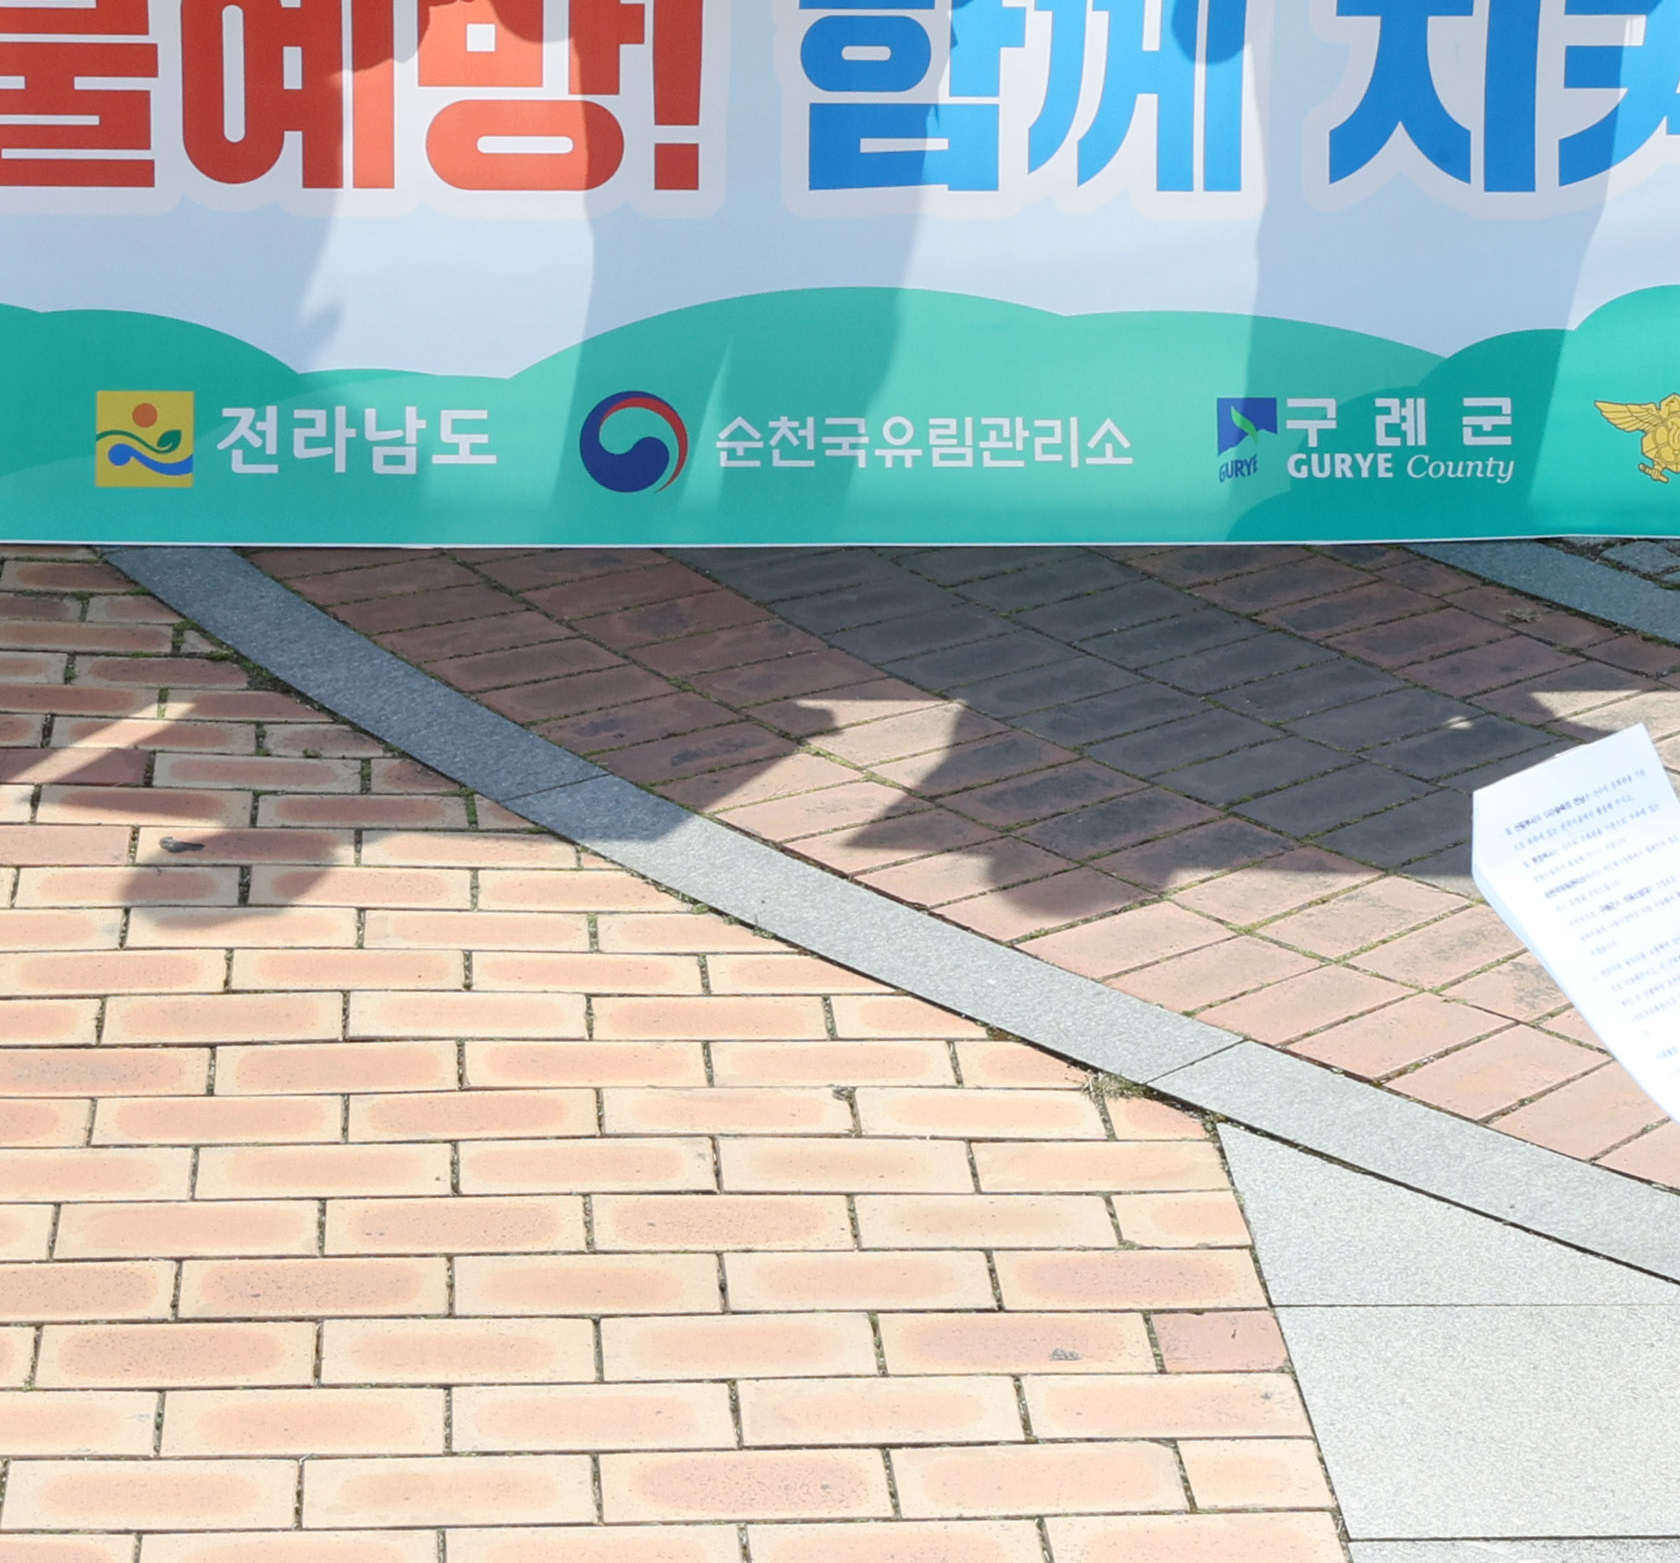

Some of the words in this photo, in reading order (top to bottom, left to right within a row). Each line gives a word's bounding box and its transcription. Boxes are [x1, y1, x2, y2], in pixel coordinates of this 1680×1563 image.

[216, 404, 498, 475] 전라남도
[715, 415, 1135, 469] 순천국유림관리소
[1218, 453, 1259, 484] GURYE
[1286, 452, 1394, 479] GURYE
[1406, 452, 1516, 485] County
